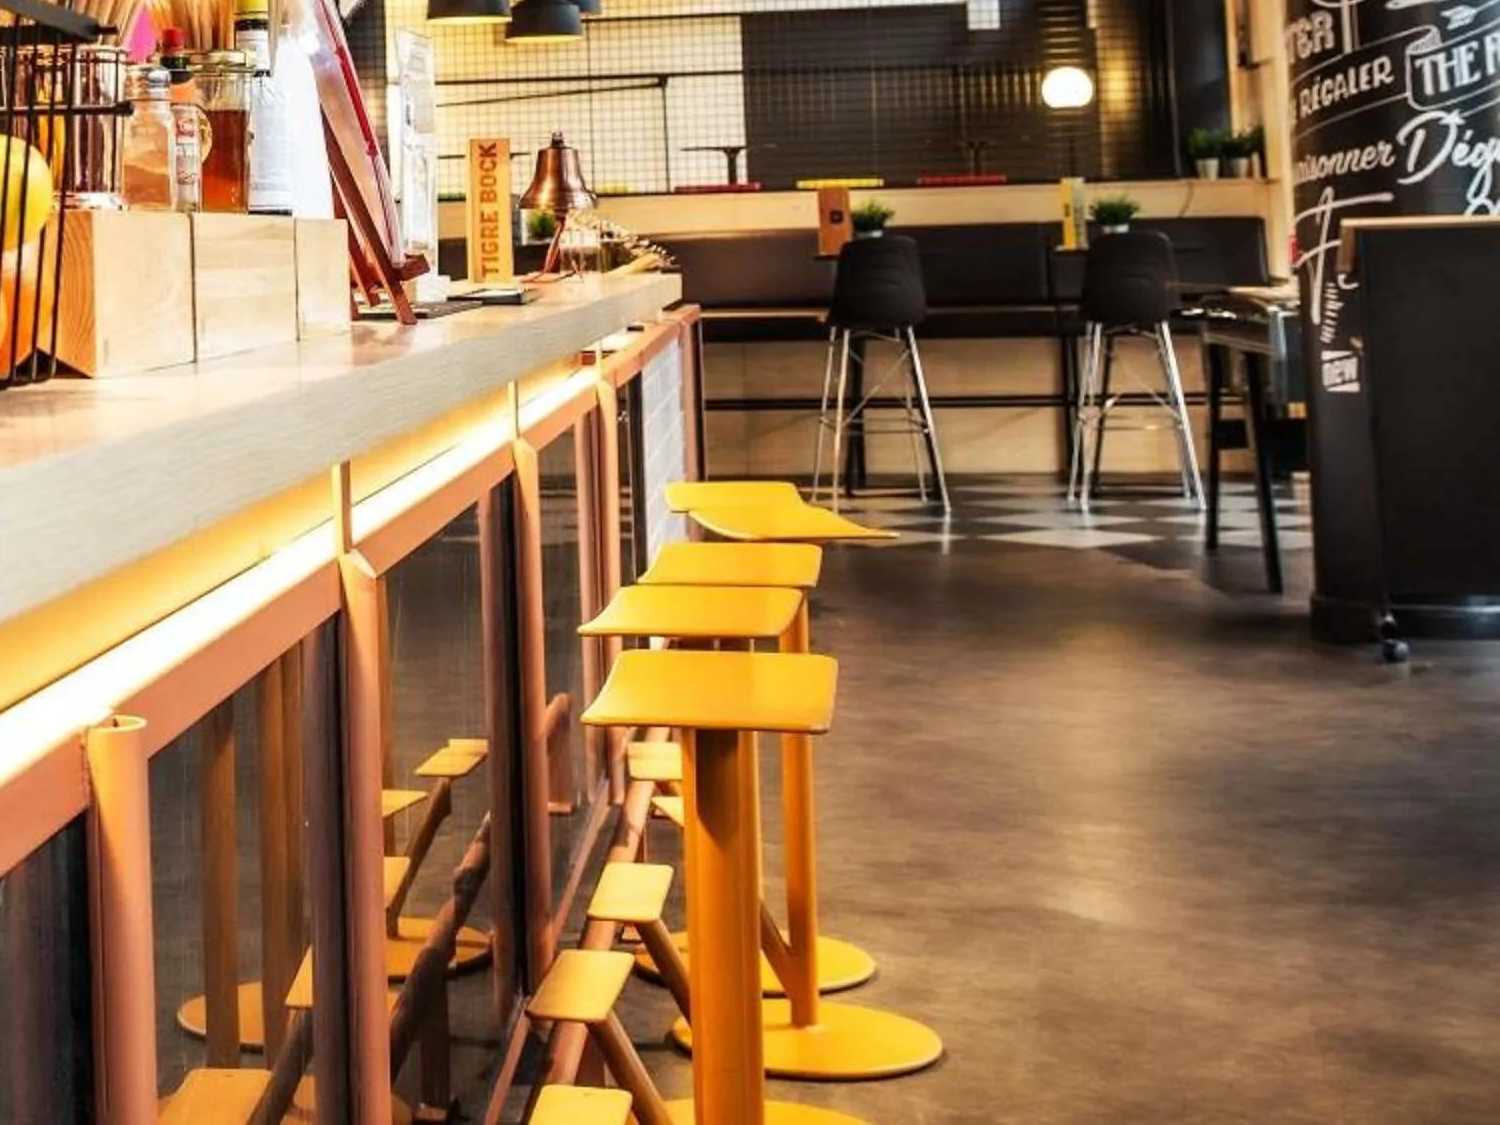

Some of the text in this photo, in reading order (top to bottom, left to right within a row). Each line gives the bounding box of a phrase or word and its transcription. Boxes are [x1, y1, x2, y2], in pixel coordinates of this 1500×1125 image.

[1299, 55, 1396, 118] RÉGALER
[1414, 40, 1482, 96] THE
[477, 141, 499, 279] TIGRE BOCK
